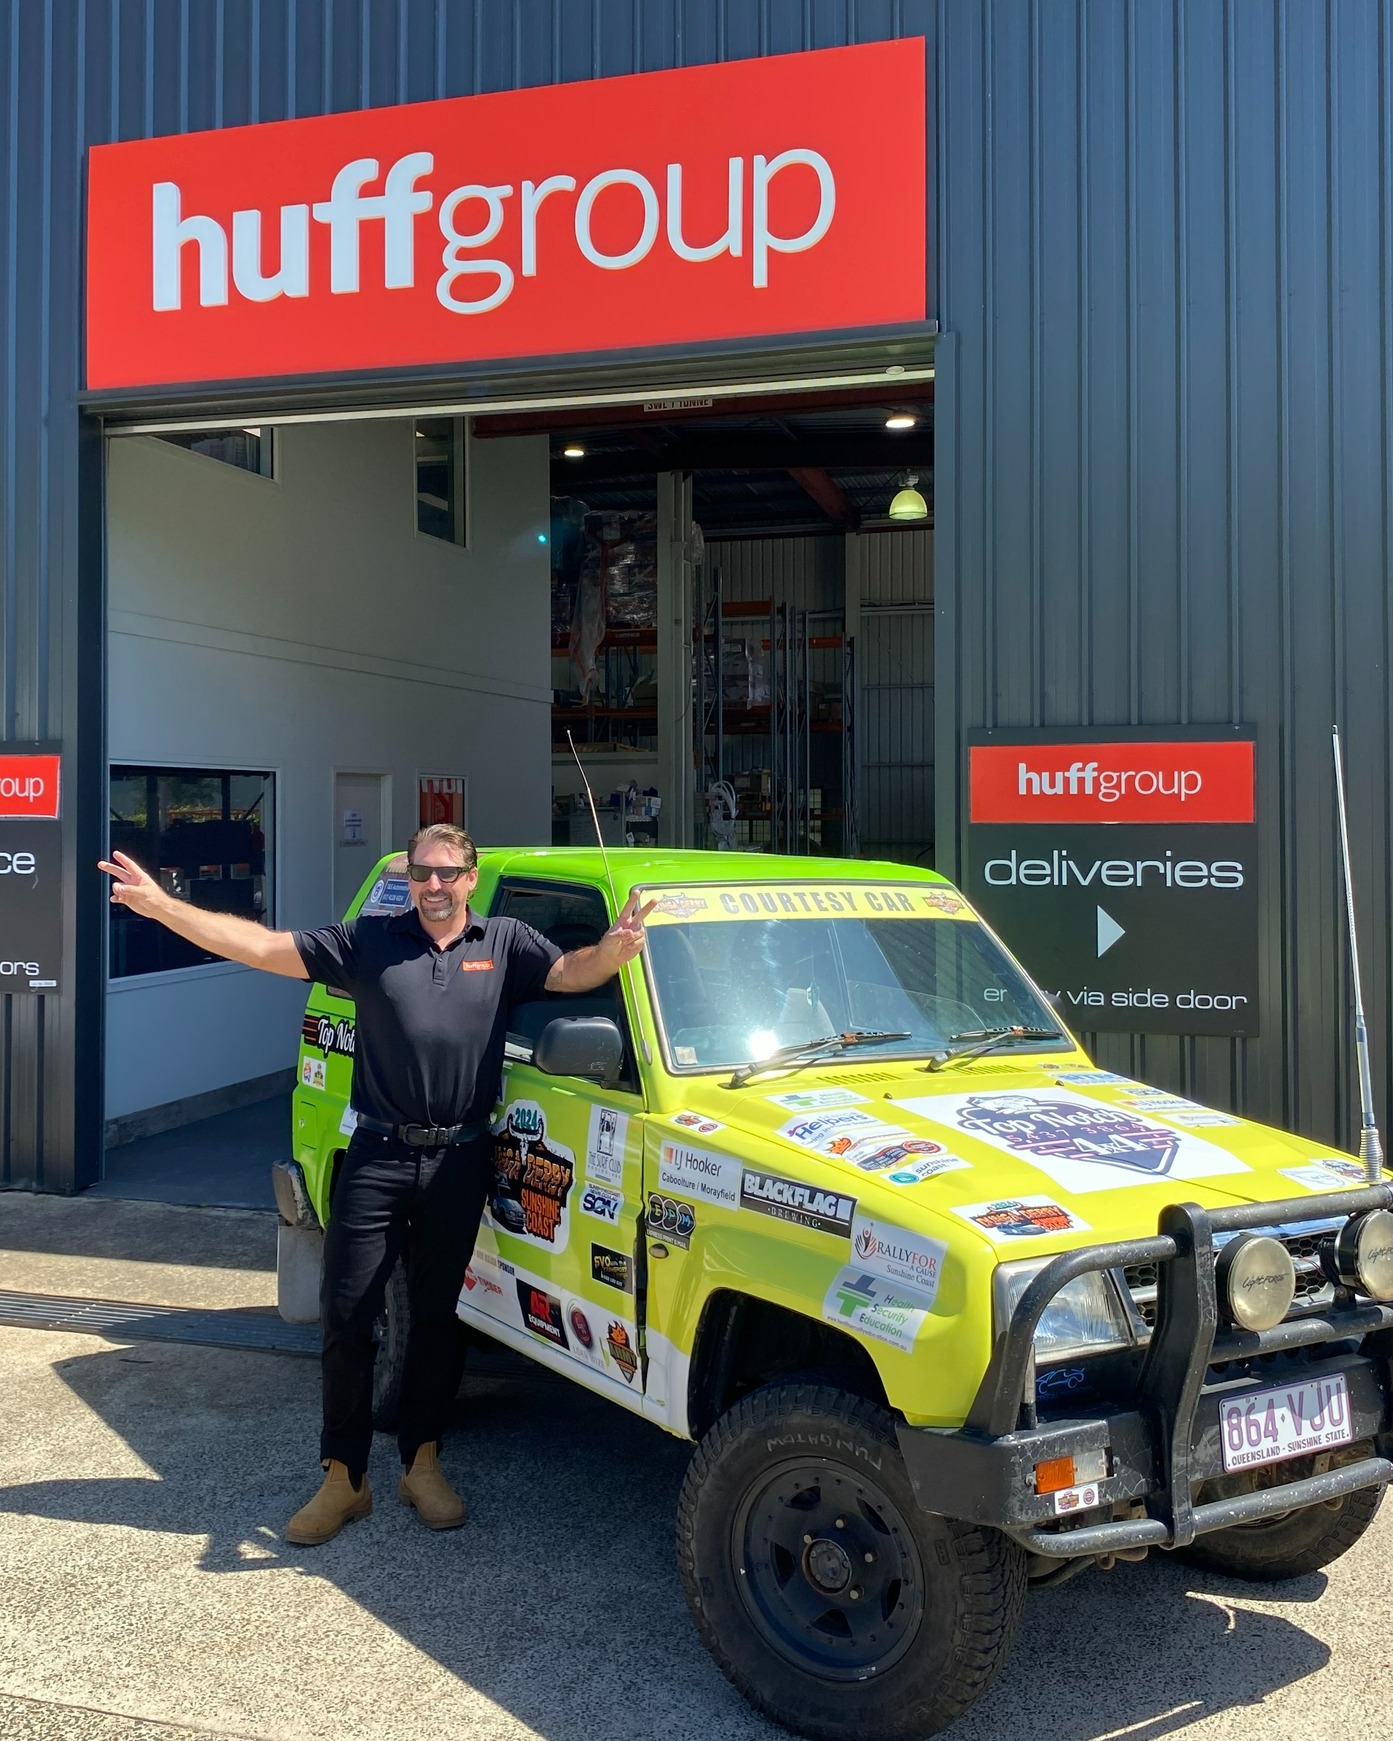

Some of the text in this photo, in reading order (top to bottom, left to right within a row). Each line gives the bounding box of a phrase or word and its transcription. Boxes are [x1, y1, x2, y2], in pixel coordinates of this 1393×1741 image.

[153, 149, 836, 314] huffgroup
[1018, 762, 1202, 802] huffgroup
[984, 850, 1244, 888] deliveries
[719, 892, 859, 915] COURTESY
[868, 891, 916, 912] CAR
[1067, 986, 1104, 1006] via
[1111, 988, 1169, 1008] side
[1176, 989, 1248, 1010] door
[318, 1018, 335, 1053] Top
[515, 1107, 538, 1130] 2024
[795, 1114, 868, 1140] Helpers
[964, 1108, 1143, 1136] Top Notch
[1006, 1128, 1070, 1143] 5437
[674, 1149, 722, 1177] LJ Hooker
[915, 1158, 959, 1174] sunshine
[662, 1172, 695, 1191] Caboolture
[700, 1183, 736, 1202] Morayfield
[743, 1174, 838, 1216] BLACKFLAG
[521, 1188, 561, 1221] SUNSHINE
[526, 1210, 556, 1241] COAST
[886, 1265, 935, 1288] Sunshine Coast
[915, 1266, 937, 1279] CAUSE
[871, 1303, 909, 1326] Security
[884, 1294, 916, 1313] Health
[528, 1313, 561, 1338] EQUIPMENT
[859, 1313, 903, 1338] Education
[1227, 1383, 1344, 1452] 864 VJU
[1231, 1446, 1281, 1466] QUEENSLAND
[1288, 1435, 1322, 1453] SUNSHINE
[1325, 1429, 1345, 1443] STATE
